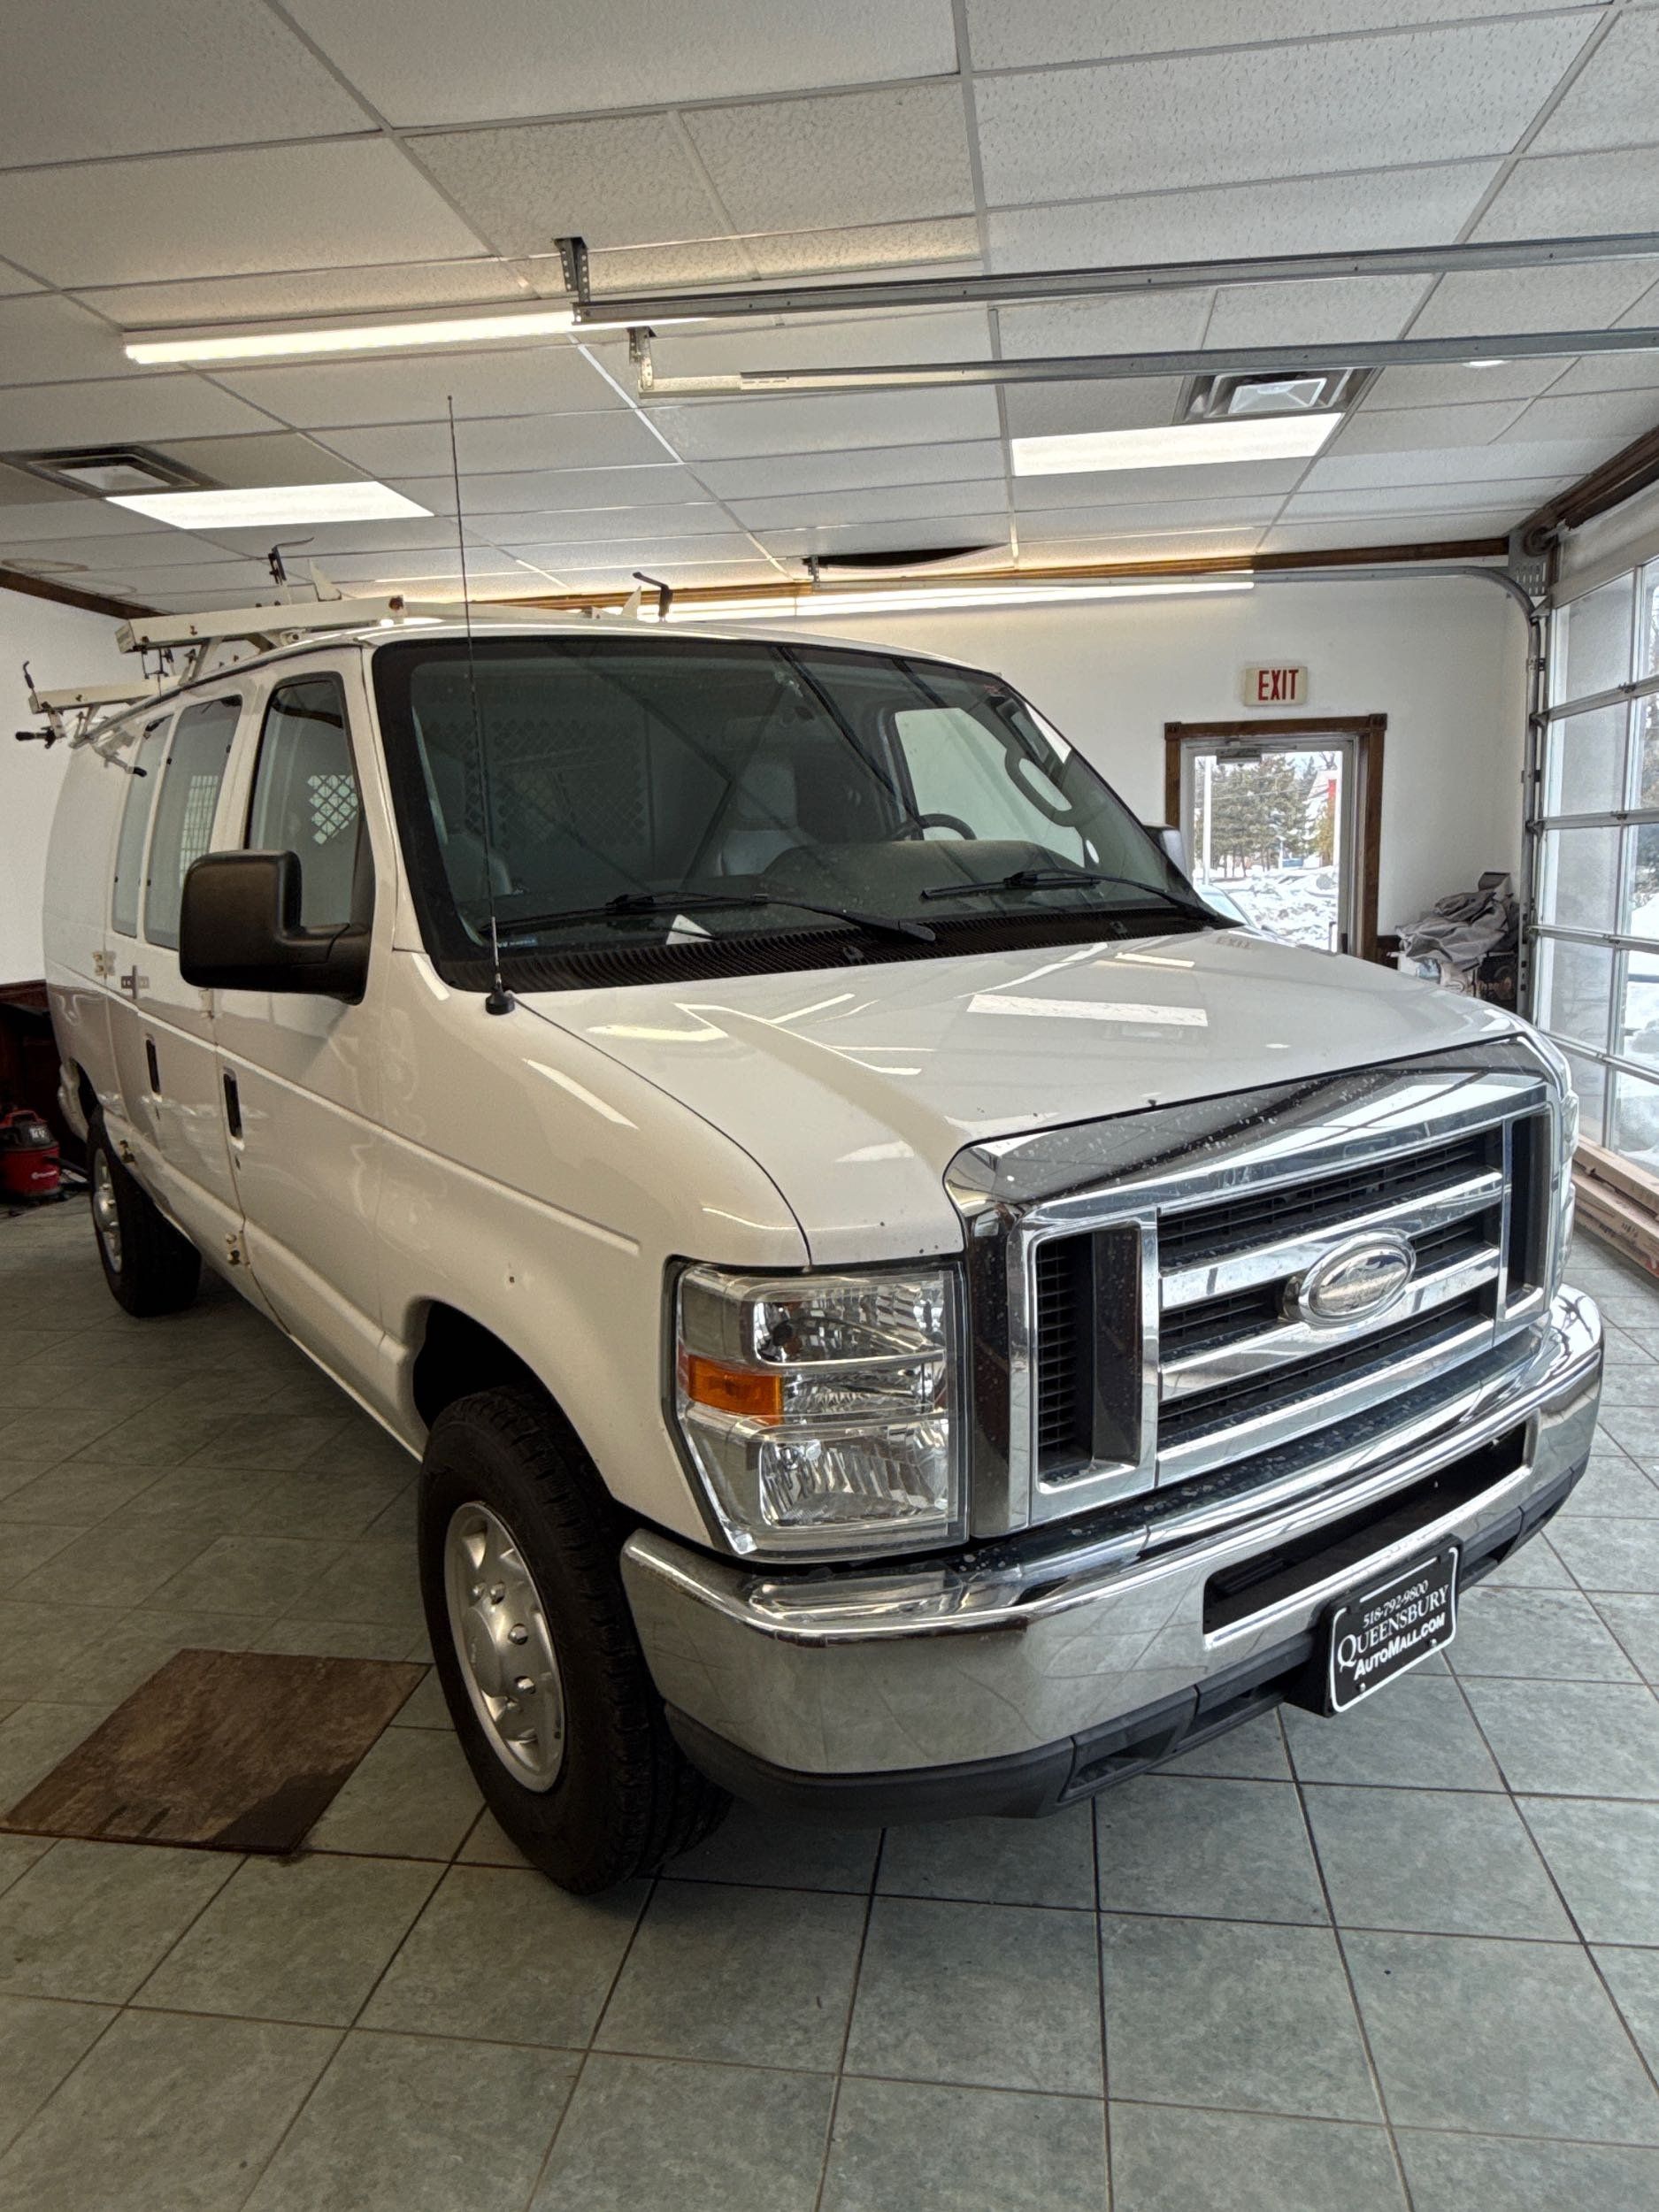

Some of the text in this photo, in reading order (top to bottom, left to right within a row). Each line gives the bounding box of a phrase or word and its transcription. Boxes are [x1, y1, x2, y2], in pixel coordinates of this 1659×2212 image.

[1258, 669, 1299, 701] EXIT
[1363, 1579, 1429, 1627] 518-792-9800
[1337, 1584, 1449, 1673] QUEENSBURY
